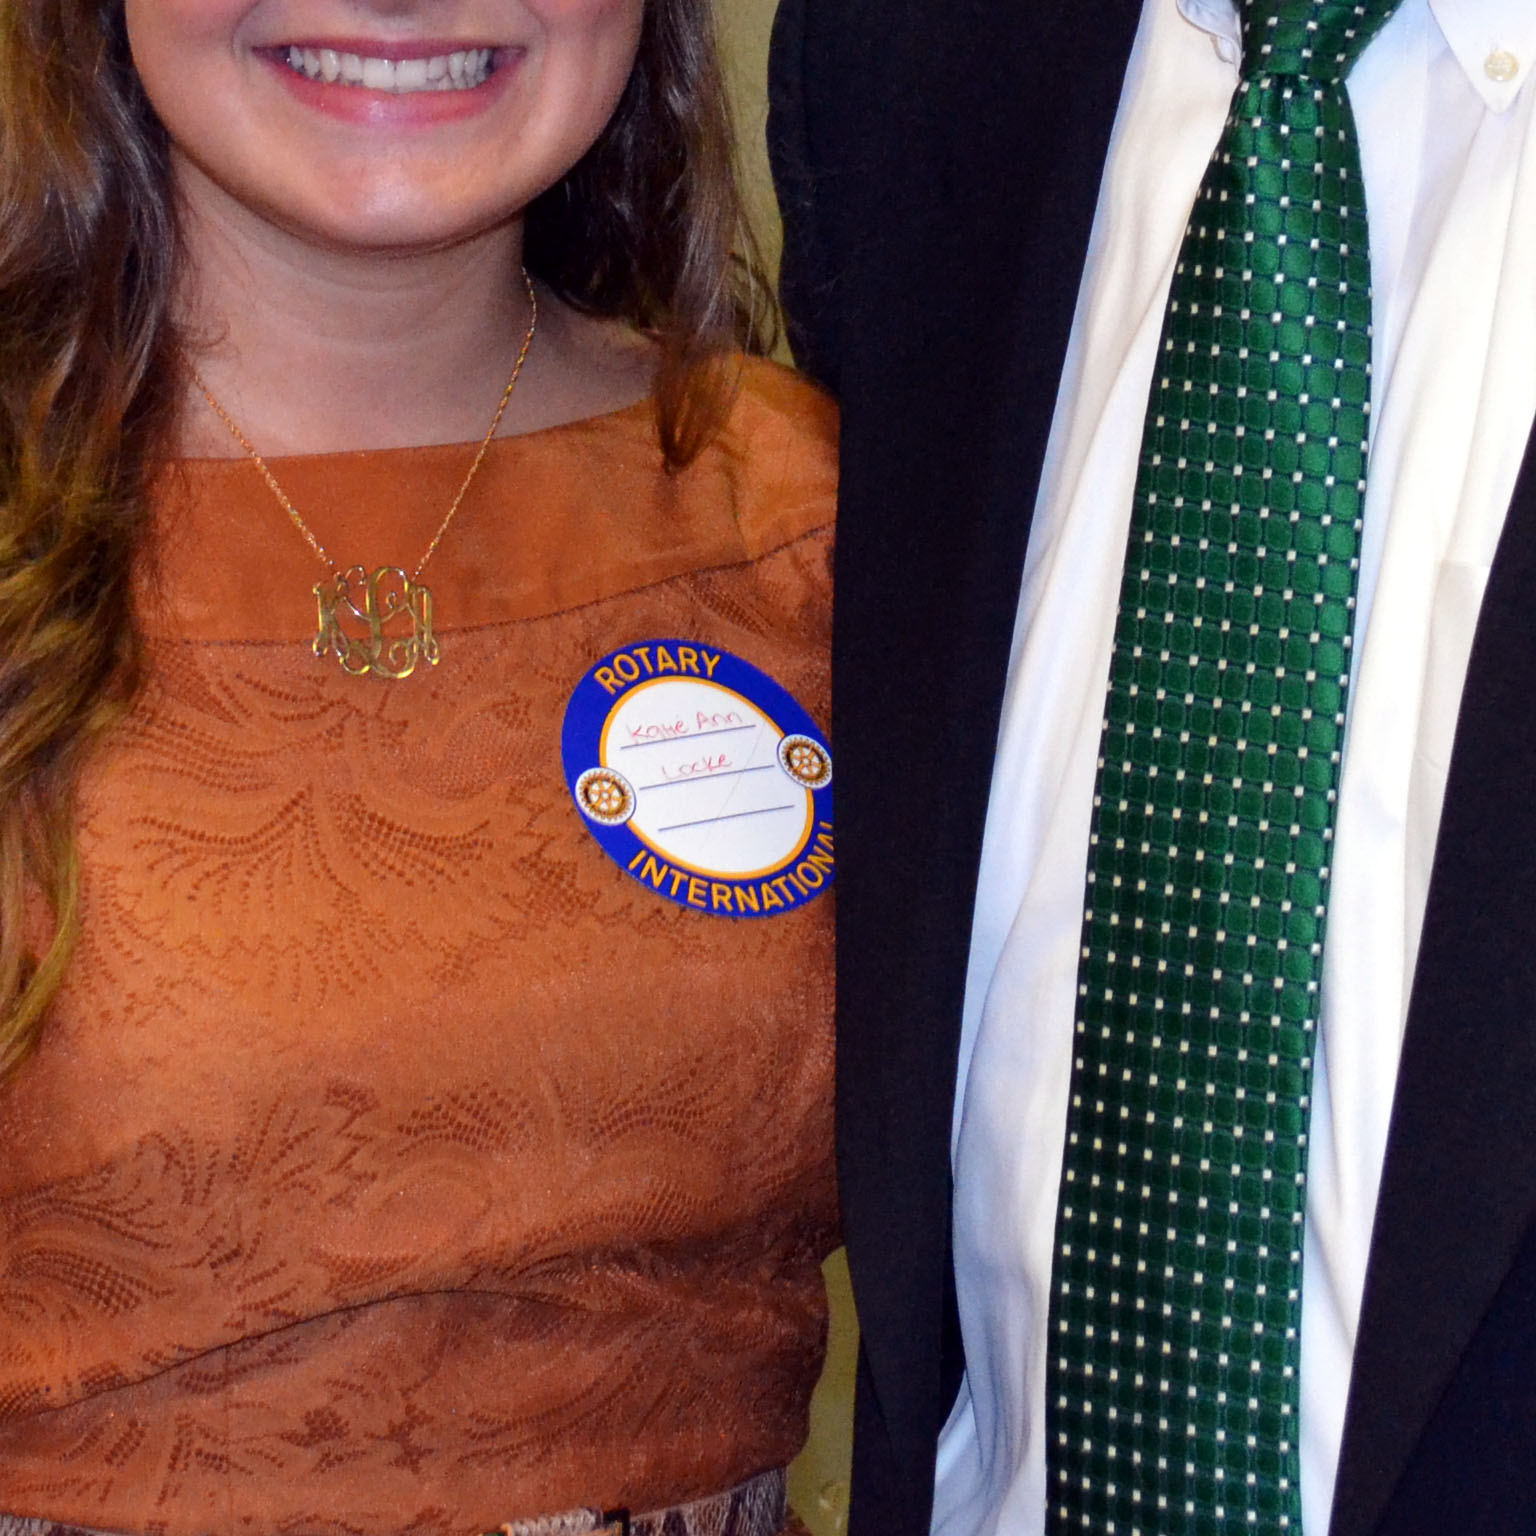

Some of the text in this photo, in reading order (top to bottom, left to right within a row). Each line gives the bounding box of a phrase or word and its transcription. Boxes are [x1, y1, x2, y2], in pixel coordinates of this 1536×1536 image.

[593, 645, 721, 696] ROTARY
[696, 711, 743, 730] Ann
[661, 753, 733, 780] Locke
